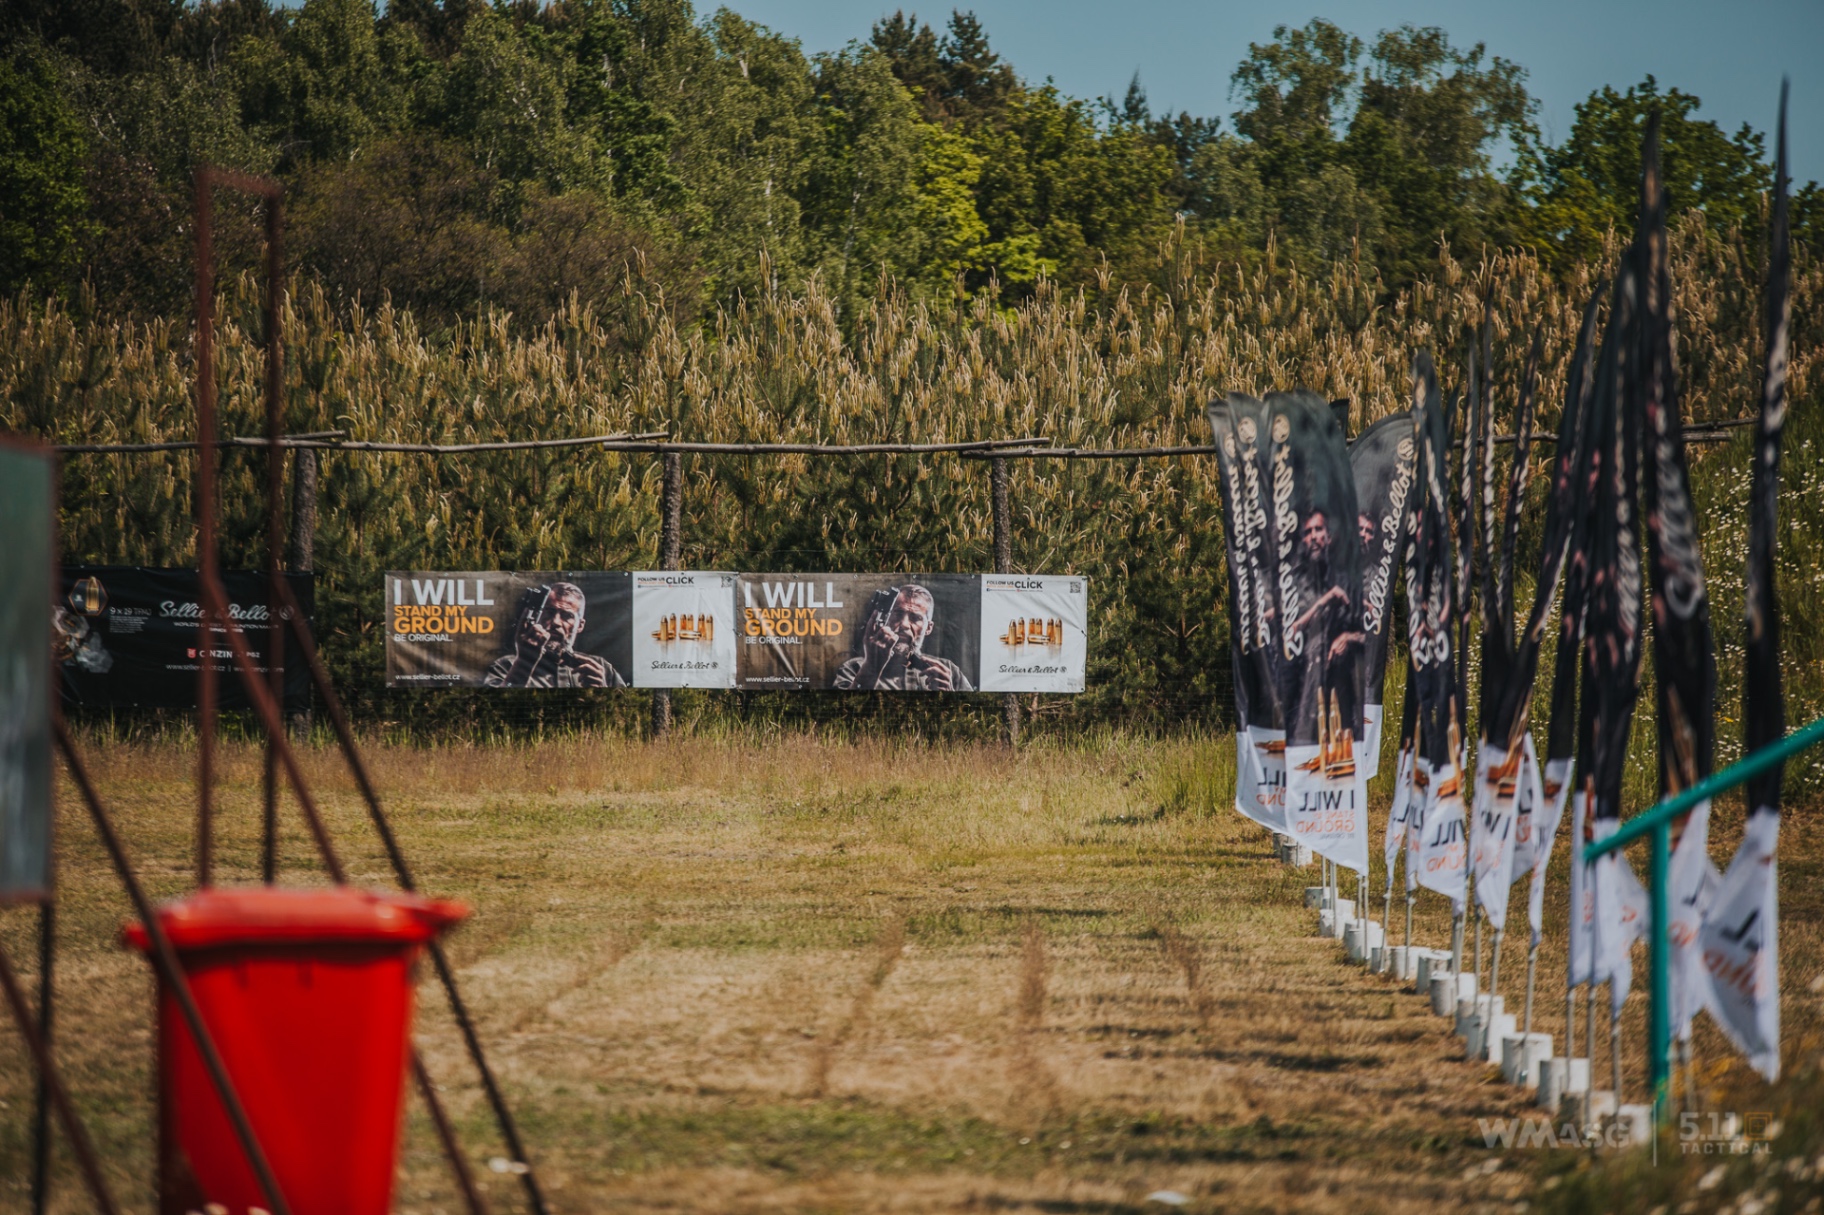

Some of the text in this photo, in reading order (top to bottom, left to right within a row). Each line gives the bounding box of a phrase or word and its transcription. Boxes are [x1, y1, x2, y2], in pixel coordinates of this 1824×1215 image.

[1363, 555, 1392, 636] Sellier
[1381, 461, 1411, 539] Bellot
[665, 576, 695, 584] CLICK
[1014, 580, 1043, 589] CLICK
[393, 579, 495, 606] I WILL
[744, 582, 844, 608] I WILL
[159, 600, 210, 619] Sellie
[393, 605, 468, 617] STAND MY
[744, 608, 817, 619] STAND MY
[393, 616, 495, 634] GROUND
[744, 619, 843, 636] GROUND
[393, 633, 407, 642] BE
[745, 636, 803, 645] BE ORIGINAL.
[198, 650, 233, 659] CNZIN
